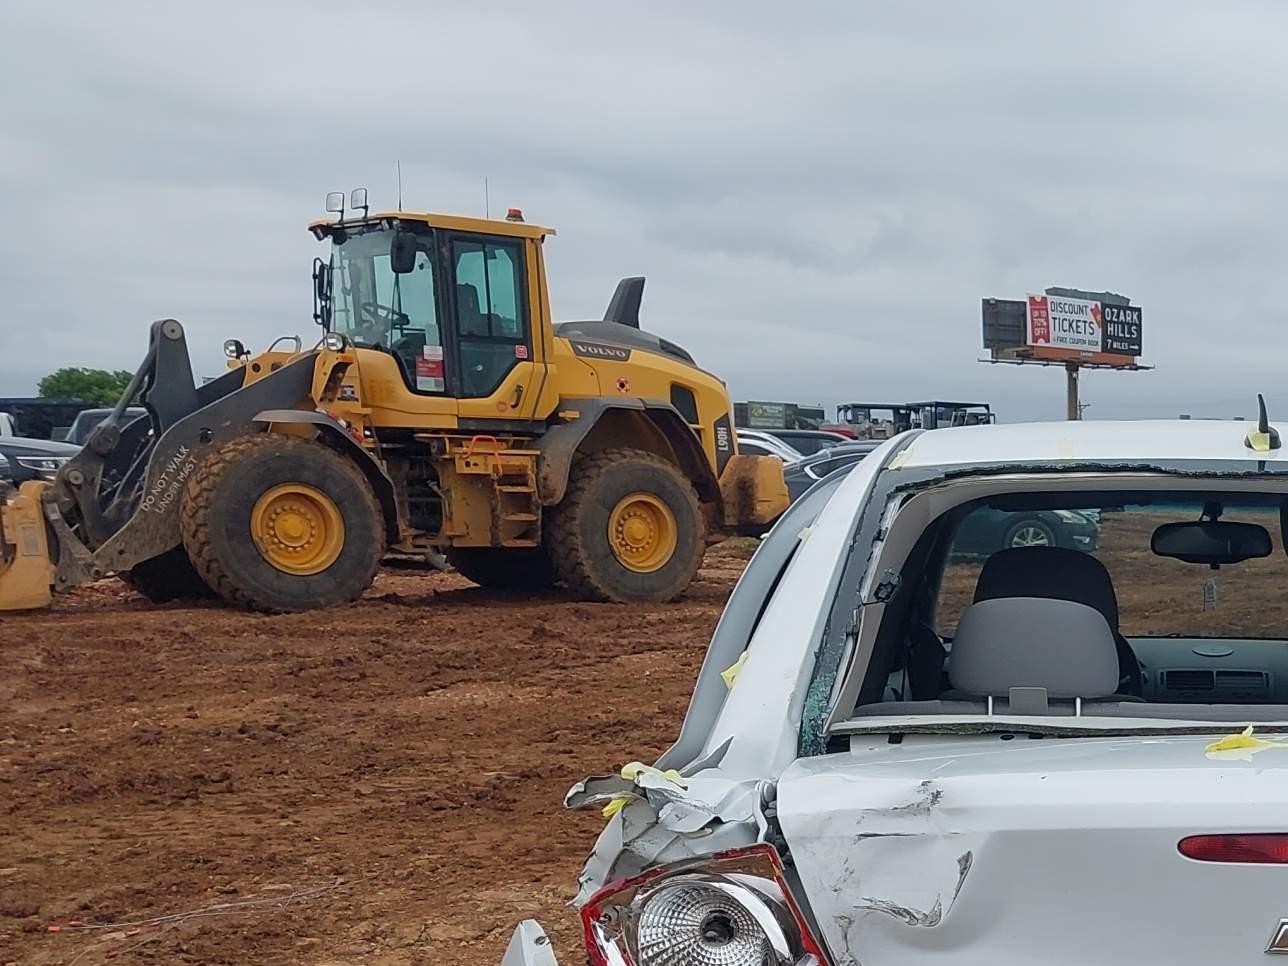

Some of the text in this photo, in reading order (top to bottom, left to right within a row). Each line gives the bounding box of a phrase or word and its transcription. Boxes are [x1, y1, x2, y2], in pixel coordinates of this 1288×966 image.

[1050, 301, 1089, 316] DISCOUNT
[1104, 307, 1139, 324] OZARK
[1051, 317, 1095, 336] TICKETS
[1107, 323, 1138, 338] HILLS
[576, 345, 626, 357] VOLVO
[1106, 339, 1129, 350] 7 MILES
[717, 427, 729, 451] L90H
[140, 445, 190, 512] DO NOT WALK
[154, 456, 198, 513] UNDER MAST
